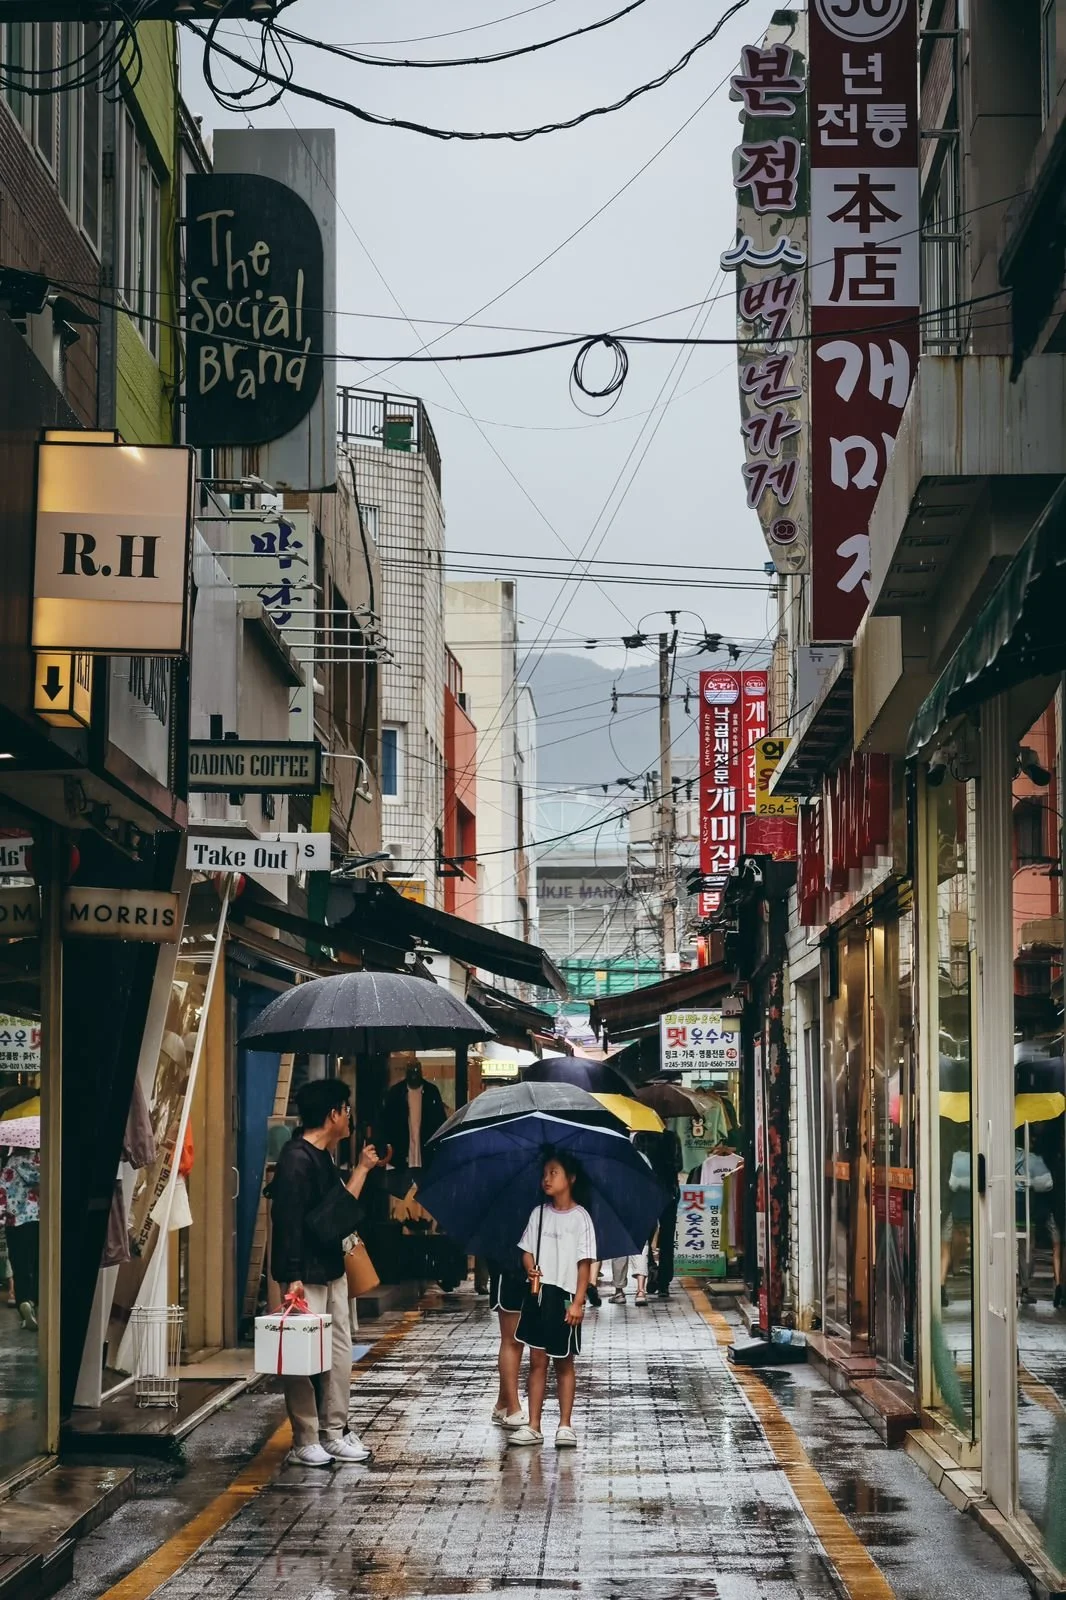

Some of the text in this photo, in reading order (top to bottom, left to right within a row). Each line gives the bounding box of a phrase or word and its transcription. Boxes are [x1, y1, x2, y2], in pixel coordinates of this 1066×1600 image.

[841, 52, 884, 96] 년
[734, 46, 801, 209] 본점
[817, 103, 909, 149] 전통
[196, 209, 271, 291] The
[827, 173, 903, 303] 本店
[190, 269, 305, 343] Social
[198, 337, 312, 401] Brand
[743, 276, 799, 504] 백년가게
[57, 531, 160, 580] R.H
[250, 754, 309, 778] COFFEE
[713, 706, 731, 785] 낙곱새전문
[706, 784, 737, 873] 개미집
[193, 844, 289, 870] Take Out
[70, 903, 175, 927] MORRIS
[667, 1026, 735, 1048] 멋 옷수선
[682, 1190, 705, 1212] 멋
[684, 1213, 706, 1251] 옷수선
